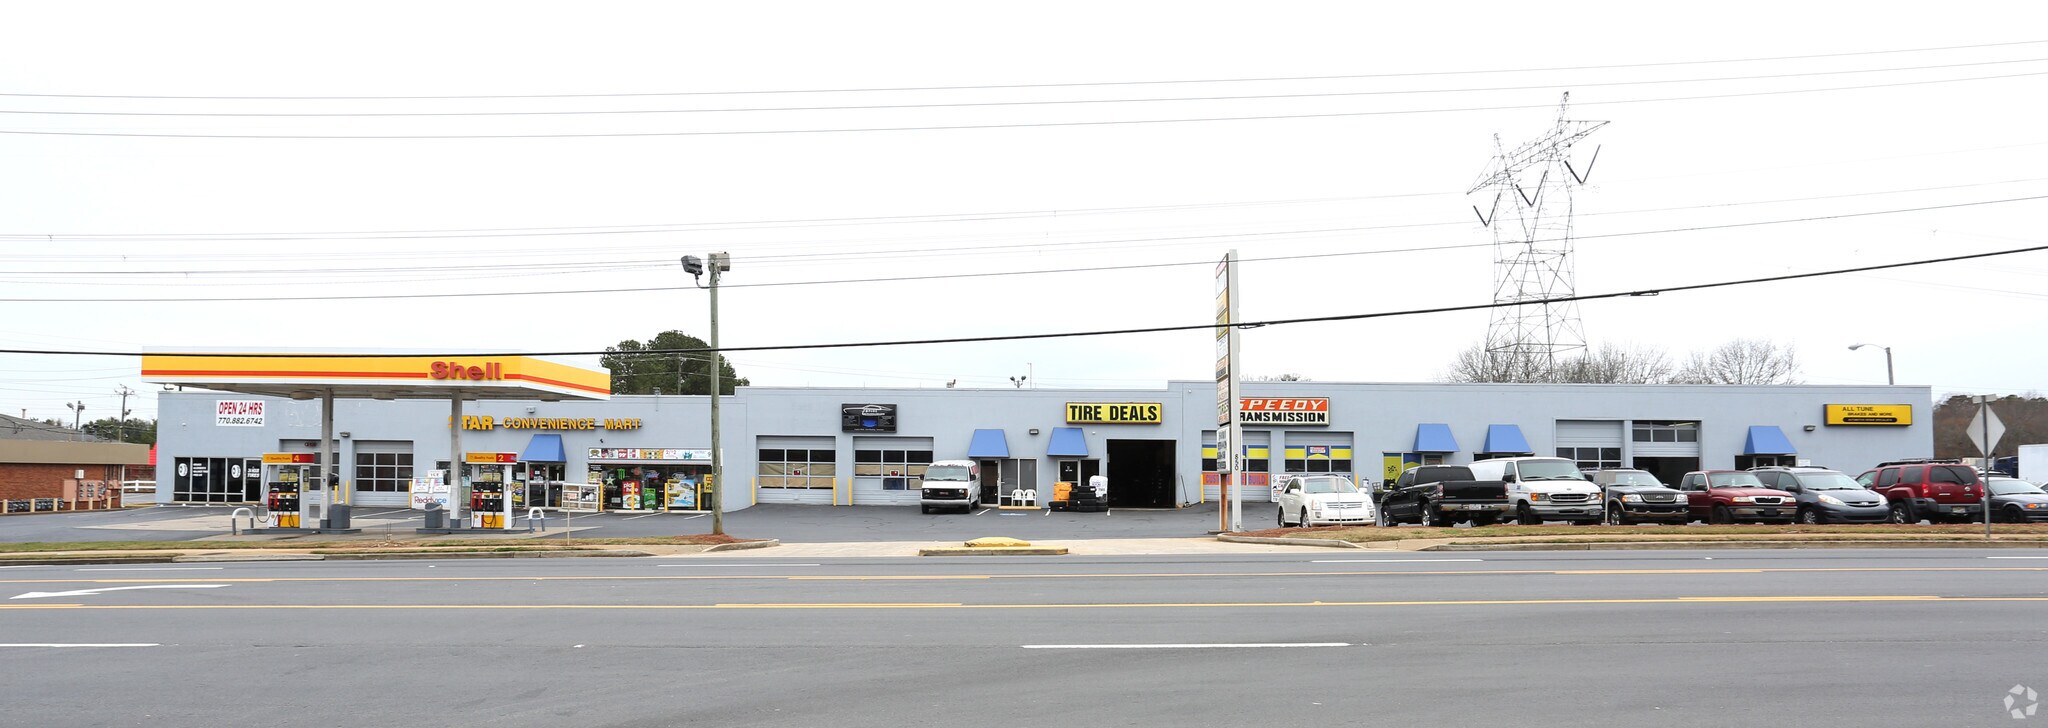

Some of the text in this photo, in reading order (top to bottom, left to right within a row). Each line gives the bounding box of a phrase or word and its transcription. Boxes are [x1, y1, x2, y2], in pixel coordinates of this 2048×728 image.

[431, 361, 501, 380] Shell
[218, 402, 264, 415] OPEN 24 HRS
[1069, 405, 1158, 421] TIRE DEALS
[217, 417, 263, 425] 770.882.6742
[1239, 412, 1326, 422] RANSMISSION
[502, 417, 595, 431] CONVENIENCE
[604, 418, 642, 430] MART
[293, 454, 301, 462] 4
[498, 454, 504, 462] 2
